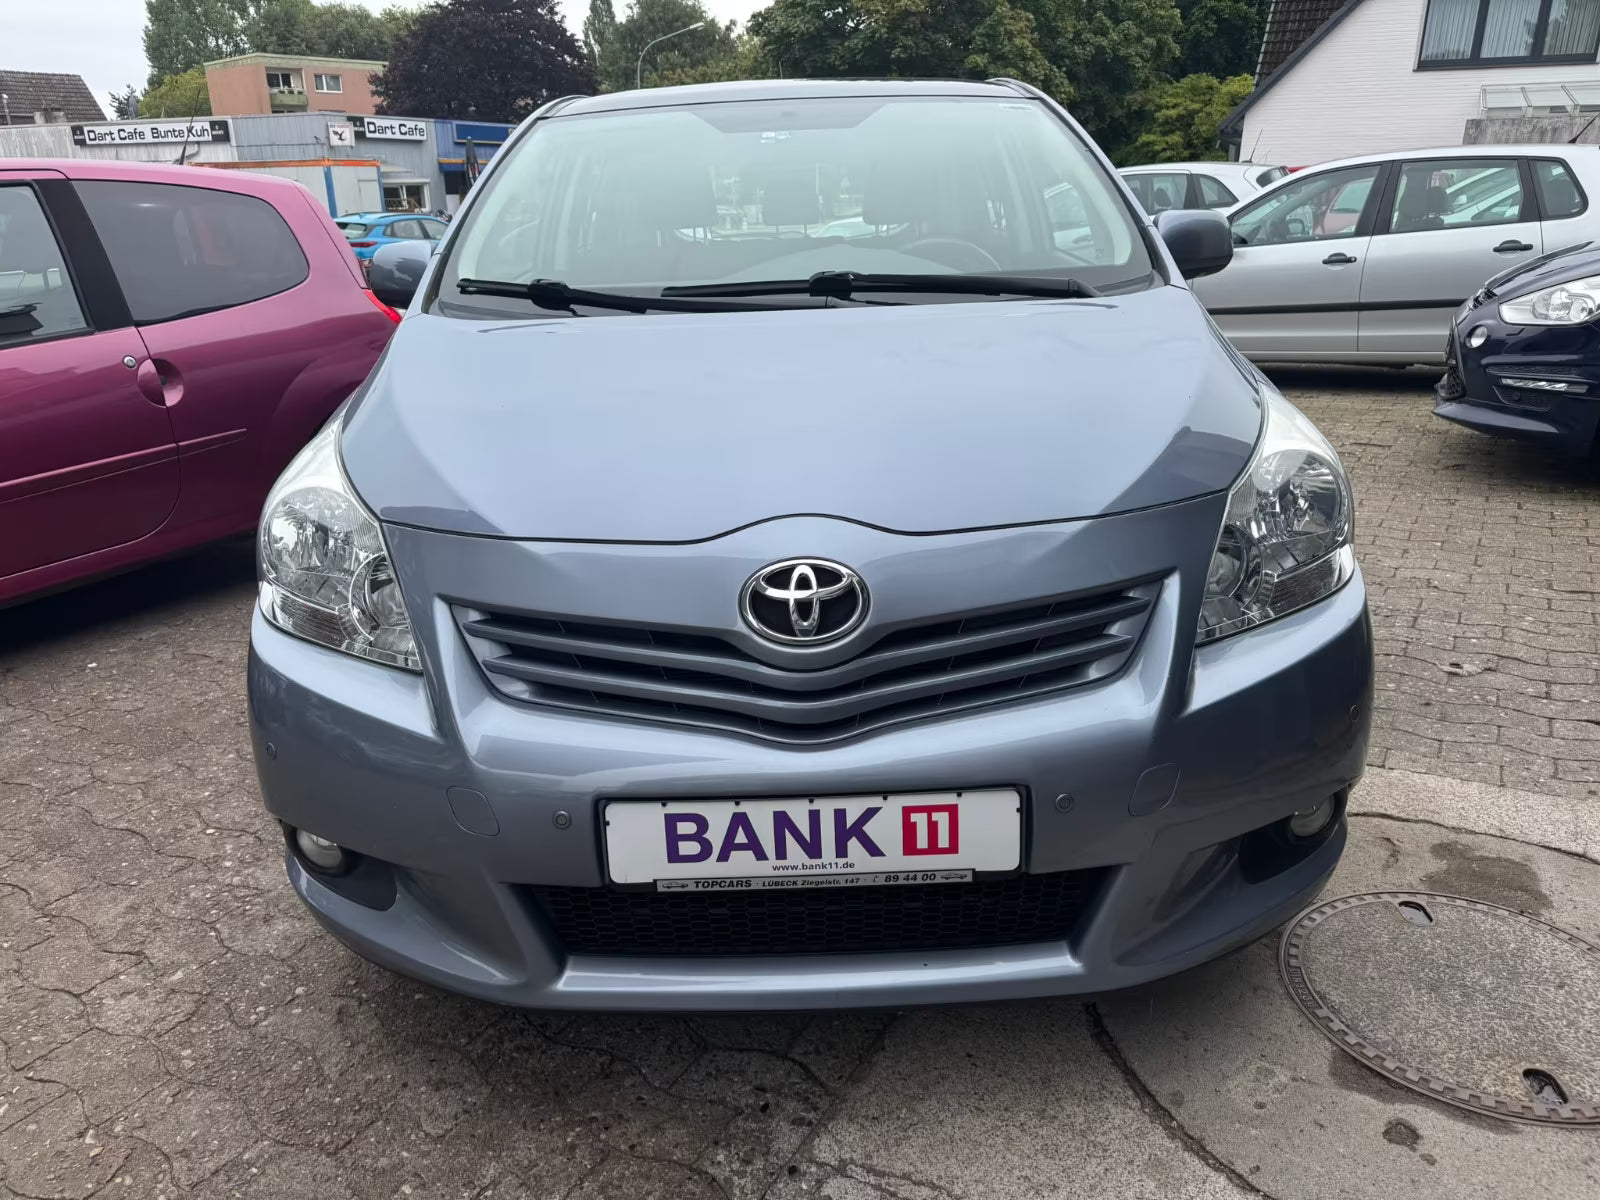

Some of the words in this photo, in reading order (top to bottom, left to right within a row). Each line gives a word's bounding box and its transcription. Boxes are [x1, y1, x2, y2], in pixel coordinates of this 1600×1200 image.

[87, 130, 115, 141] Dart
[117, 128, 146, 140] Cafe
[150, 127, 185, 139] Bunte
[186, 125, 210, 138] Kuh
[366, 121, 396, 135] Dart
[398, 123, 425, 136] Cafe
[664, 806, 886, 864] BANK
[910, 811, 950, 849] 11
[772, 861, 855, 872] www.bank11.de
[693, 879, 752, 890] TOPCARS
[762, 879, 798, 888] LÜBECK
[801, 878, 841, 887] Ziegelstr.
[844, 877, 860, 885] 147
[884, 874, 899, 883] 89
[902, 873, 918, 882] 44
[921, 873, 936, 882] 00
